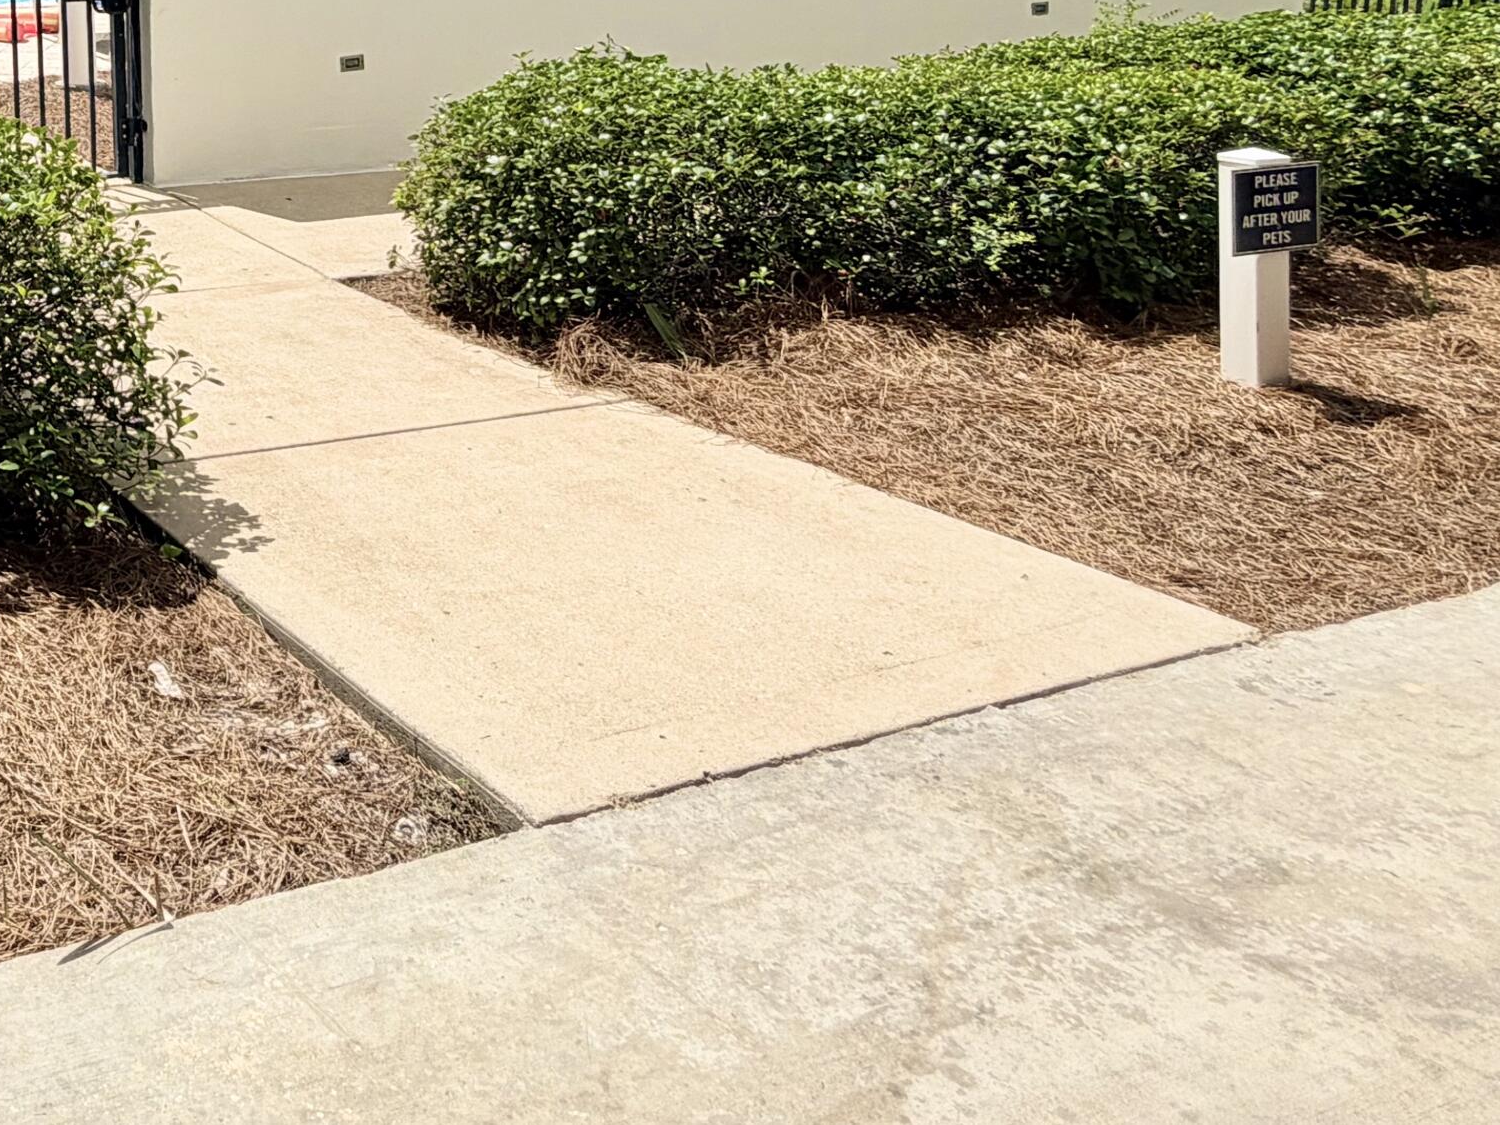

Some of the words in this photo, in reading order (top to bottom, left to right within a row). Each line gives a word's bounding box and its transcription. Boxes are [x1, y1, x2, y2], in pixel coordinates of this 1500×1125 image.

[1255, 172, 1298, 189] PLEASE
[1253, 193, 1281, 208] PICK
[1283, 191, 1299, 205] UP
[1242, 213, 1278, 229] AFTER
[1281, 209, 1311, 224] YOUR
[1262, 230, 1291, 245] PETS
